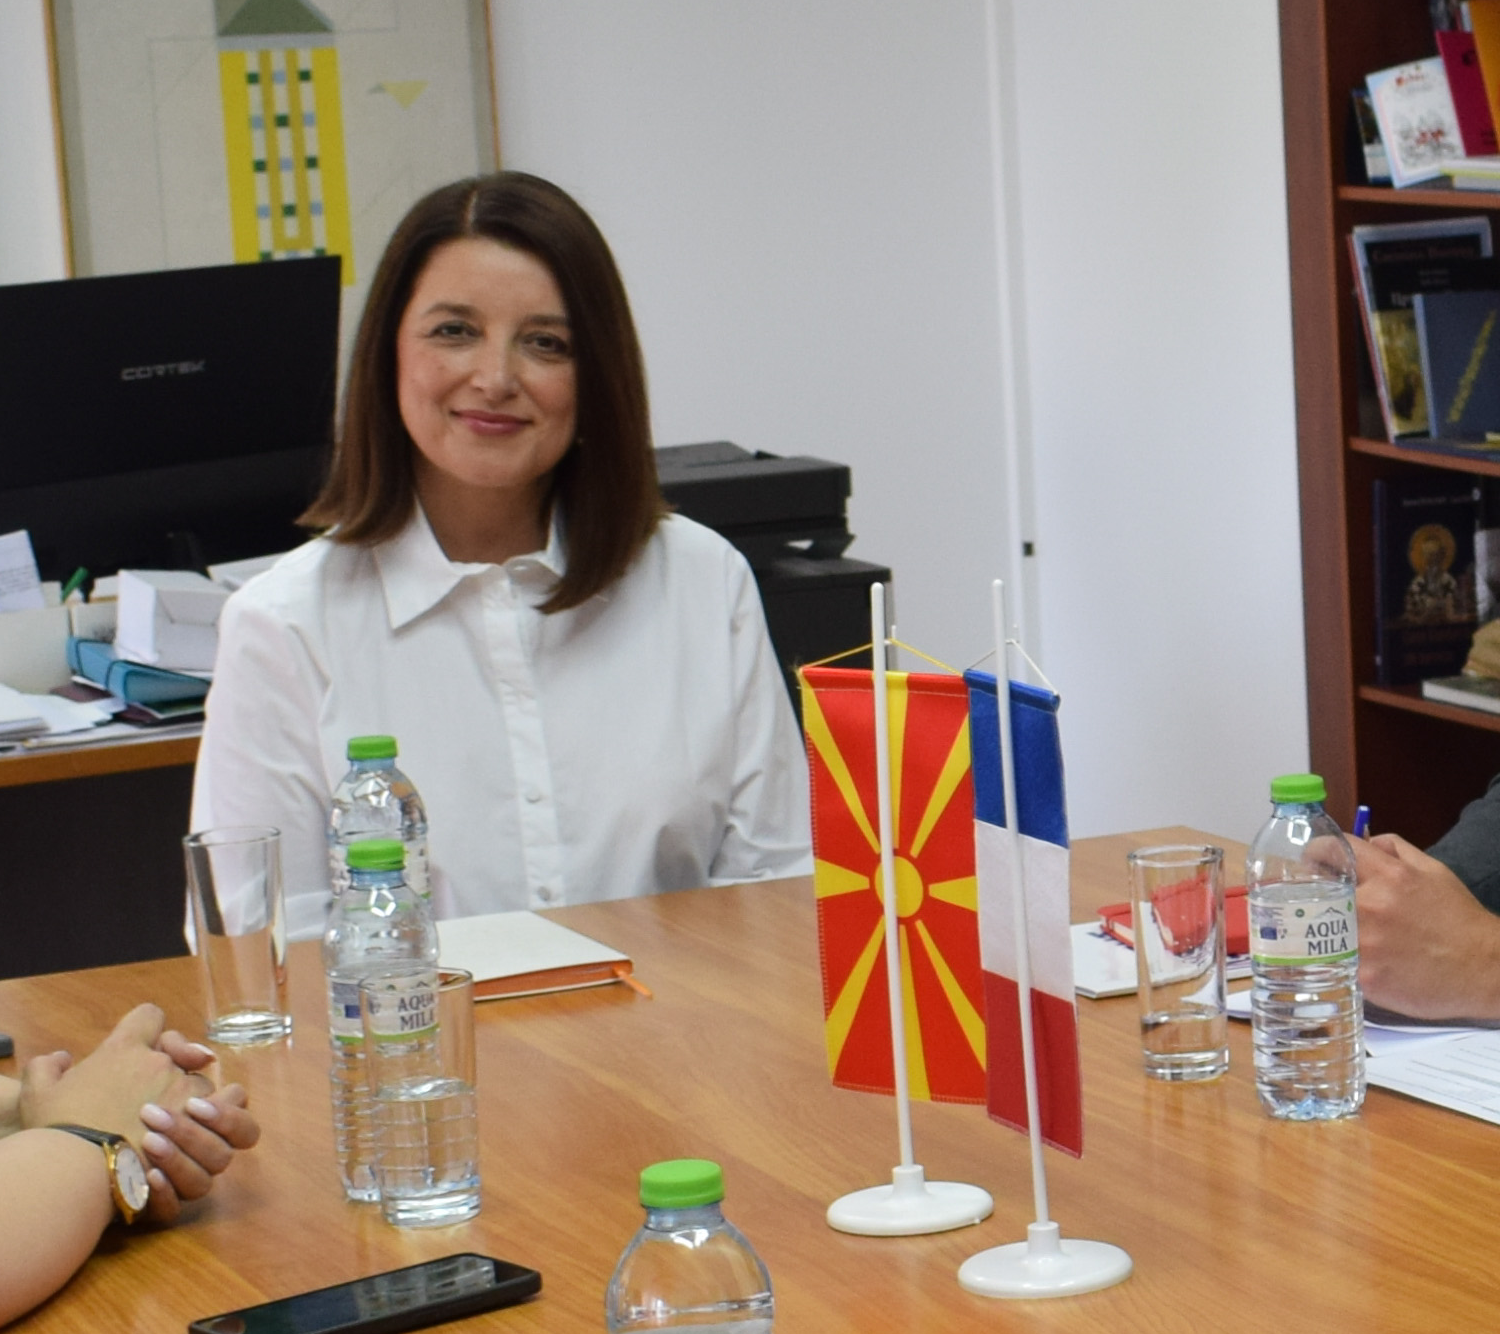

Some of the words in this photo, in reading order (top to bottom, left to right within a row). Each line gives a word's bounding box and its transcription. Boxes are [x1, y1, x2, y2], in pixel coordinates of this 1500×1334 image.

[120, 359, 206, 381] CORTEK
[1304, 919, 1349, 939] AQUA
[1307, 937, 1348, 956] MILA
